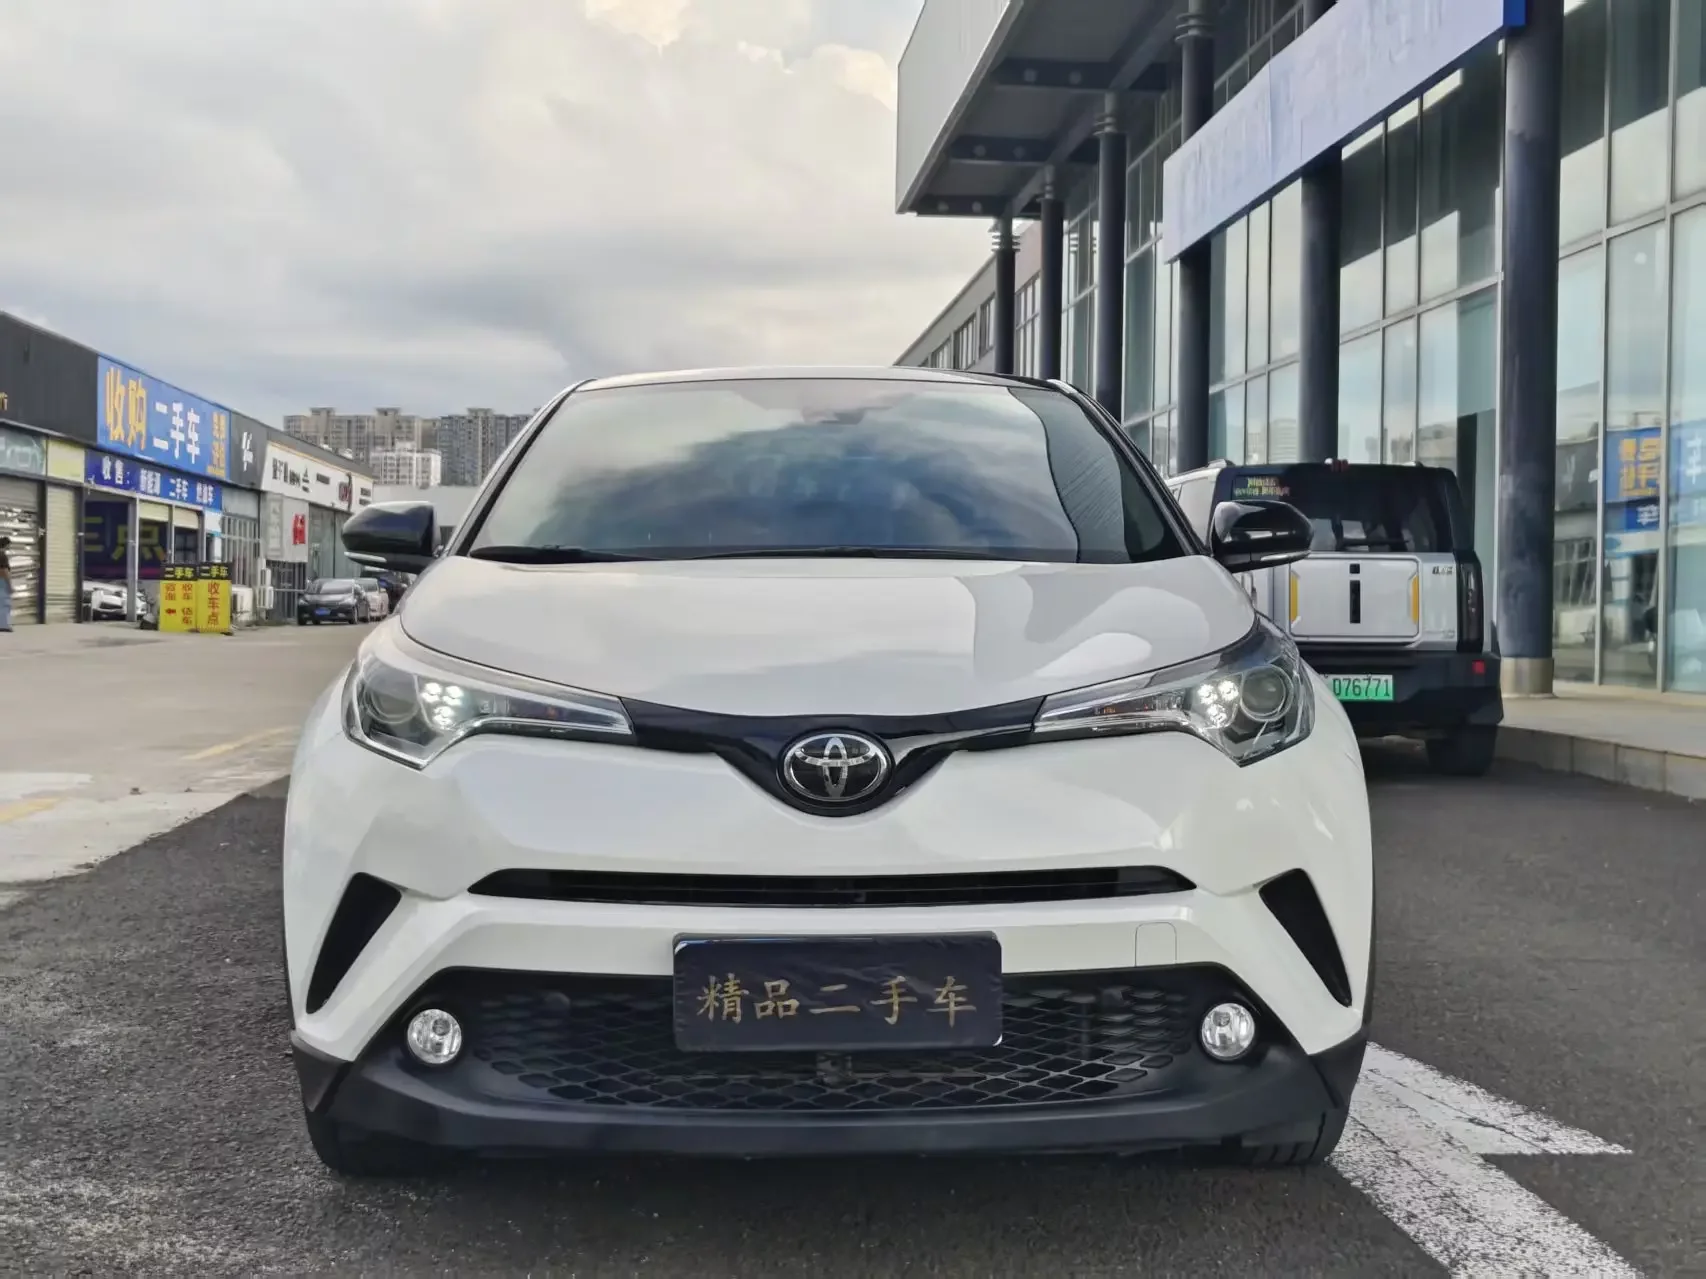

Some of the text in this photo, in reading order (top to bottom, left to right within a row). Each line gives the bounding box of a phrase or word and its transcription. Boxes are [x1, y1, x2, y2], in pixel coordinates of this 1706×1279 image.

[104, 367, 147, 450] 收购
[152, 401, 201, 464] 二手车
[697, 973, 977, 1028] 精品二手车
